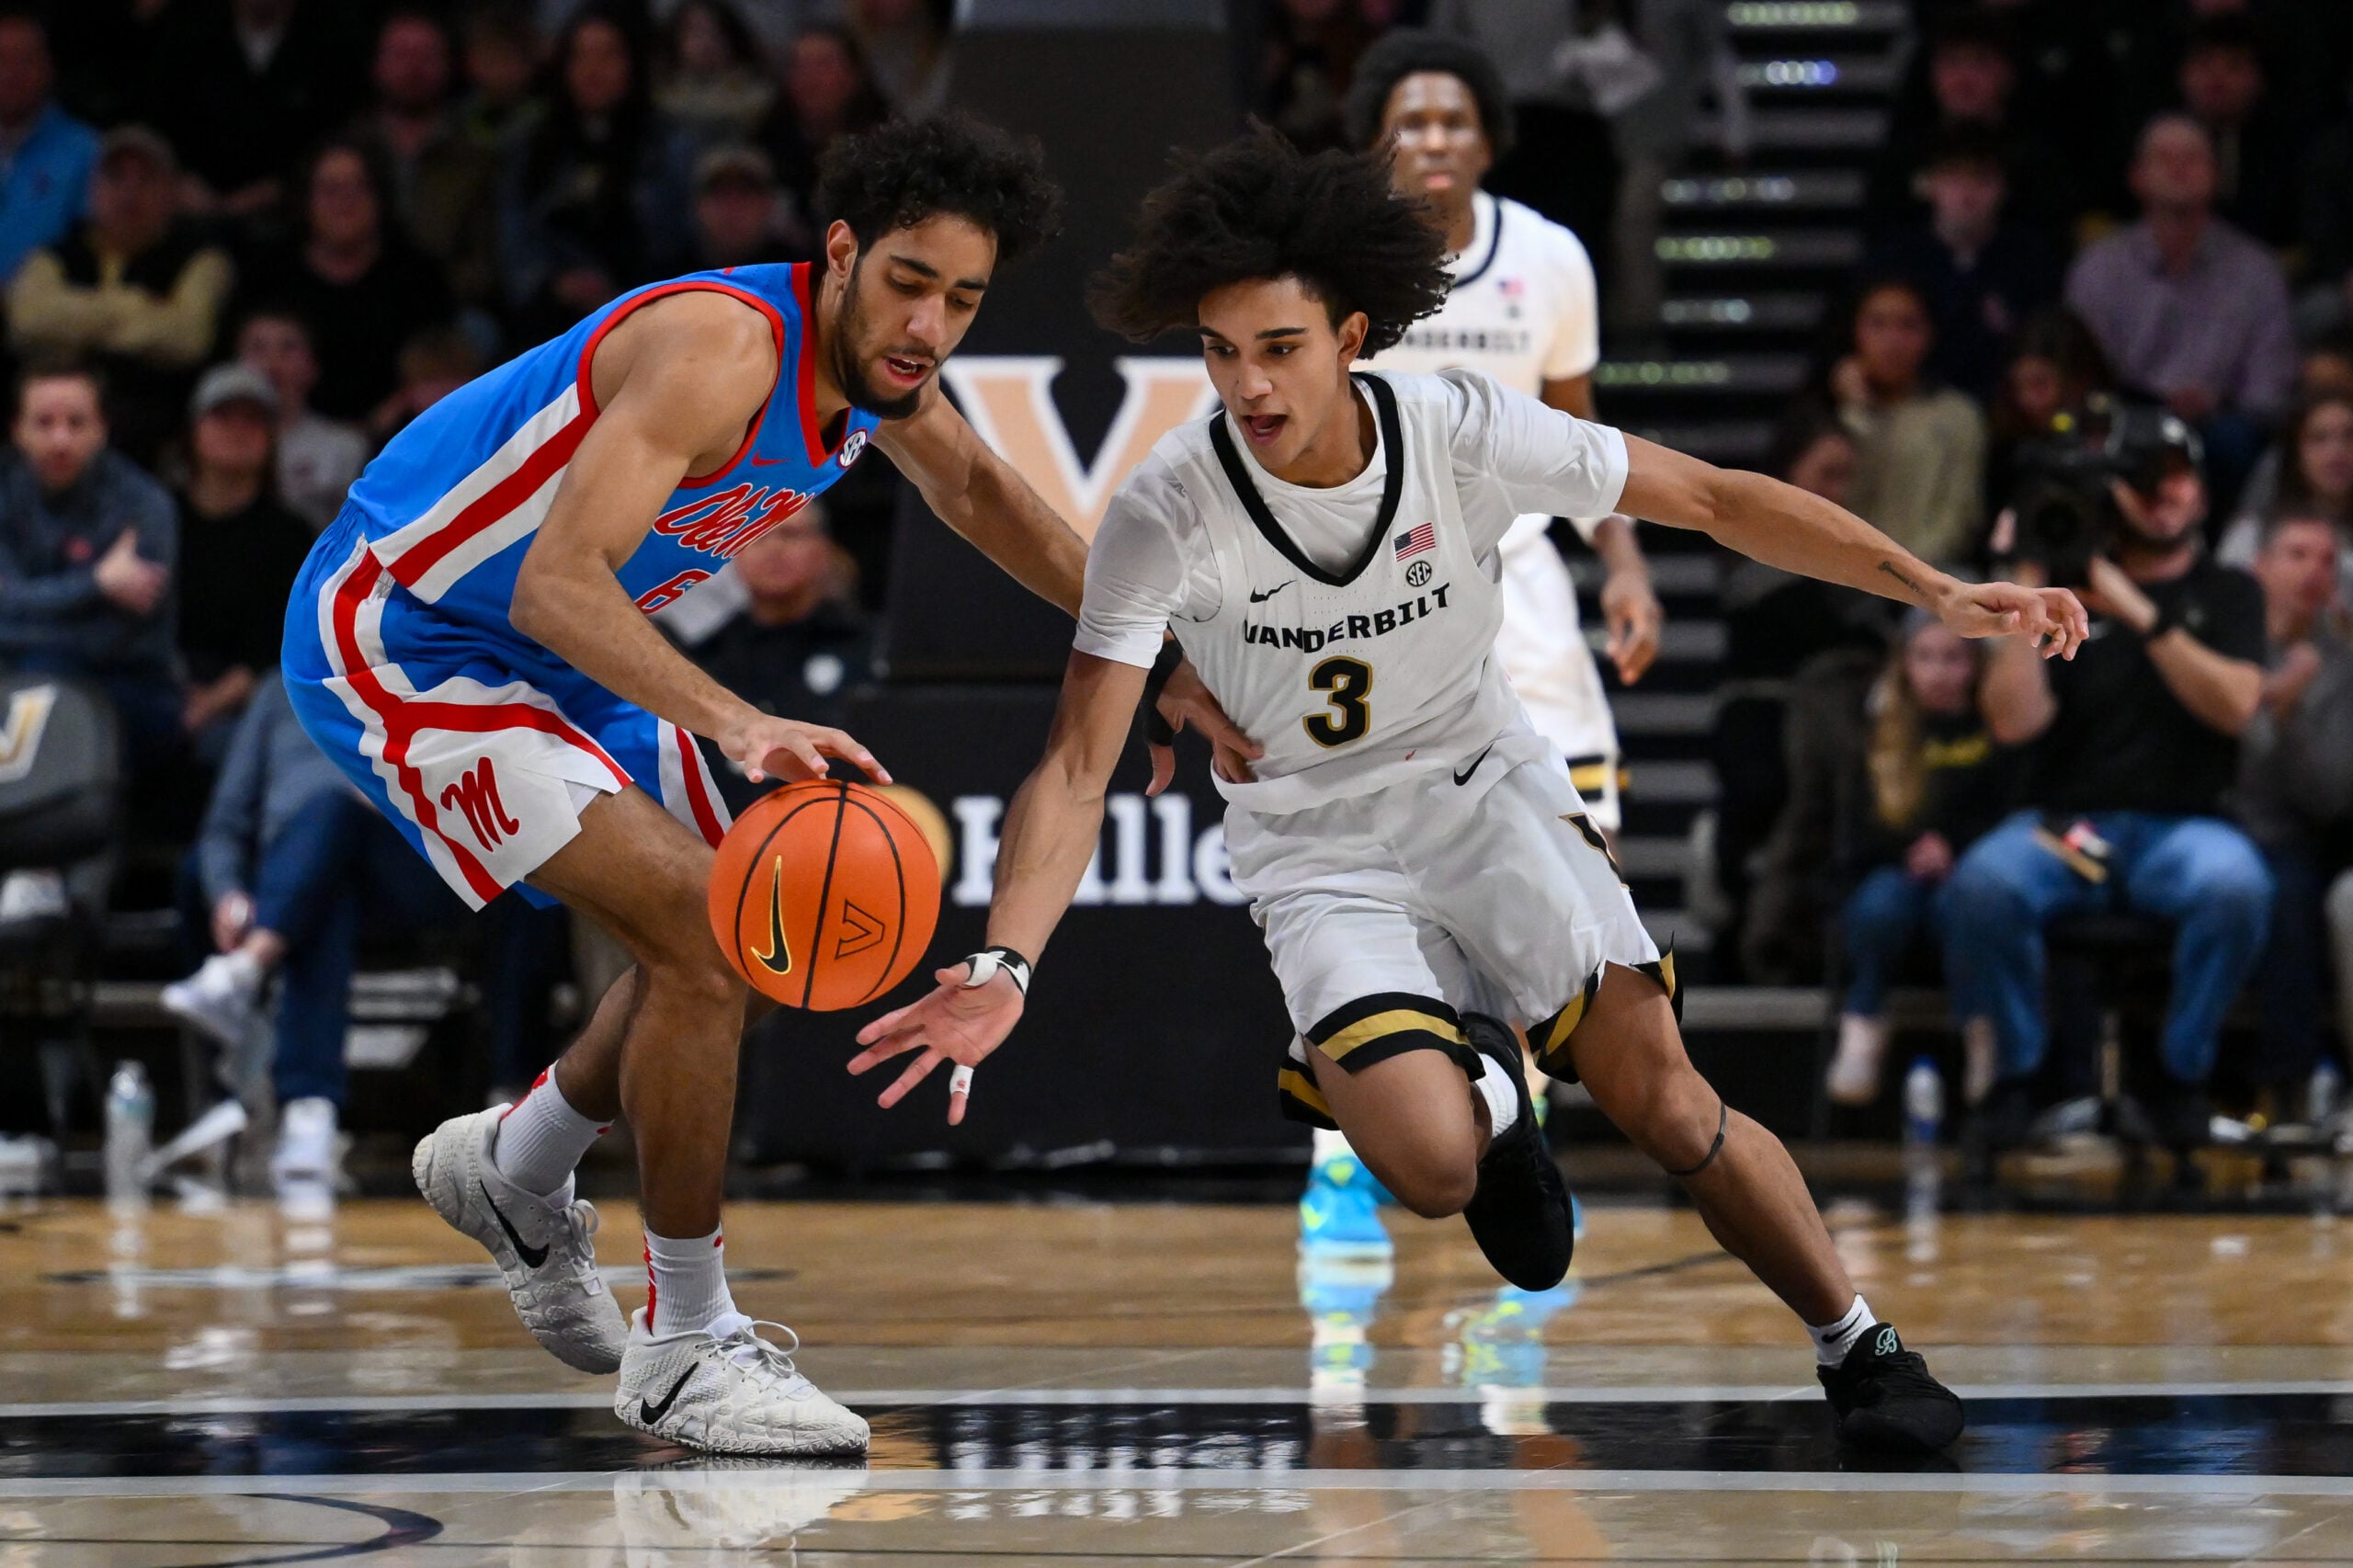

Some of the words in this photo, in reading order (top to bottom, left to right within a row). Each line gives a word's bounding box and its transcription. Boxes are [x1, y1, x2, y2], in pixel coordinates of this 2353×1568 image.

[634, 568, 712, 615] 6
[1408, 565, 1430, 585] SEC
[1244, 582, 1449, 653] VANDERBILT
[1302, 655, 1374, 749] 3
[439, 756, 520, 853] M
[834, 898, 886, 960] V
